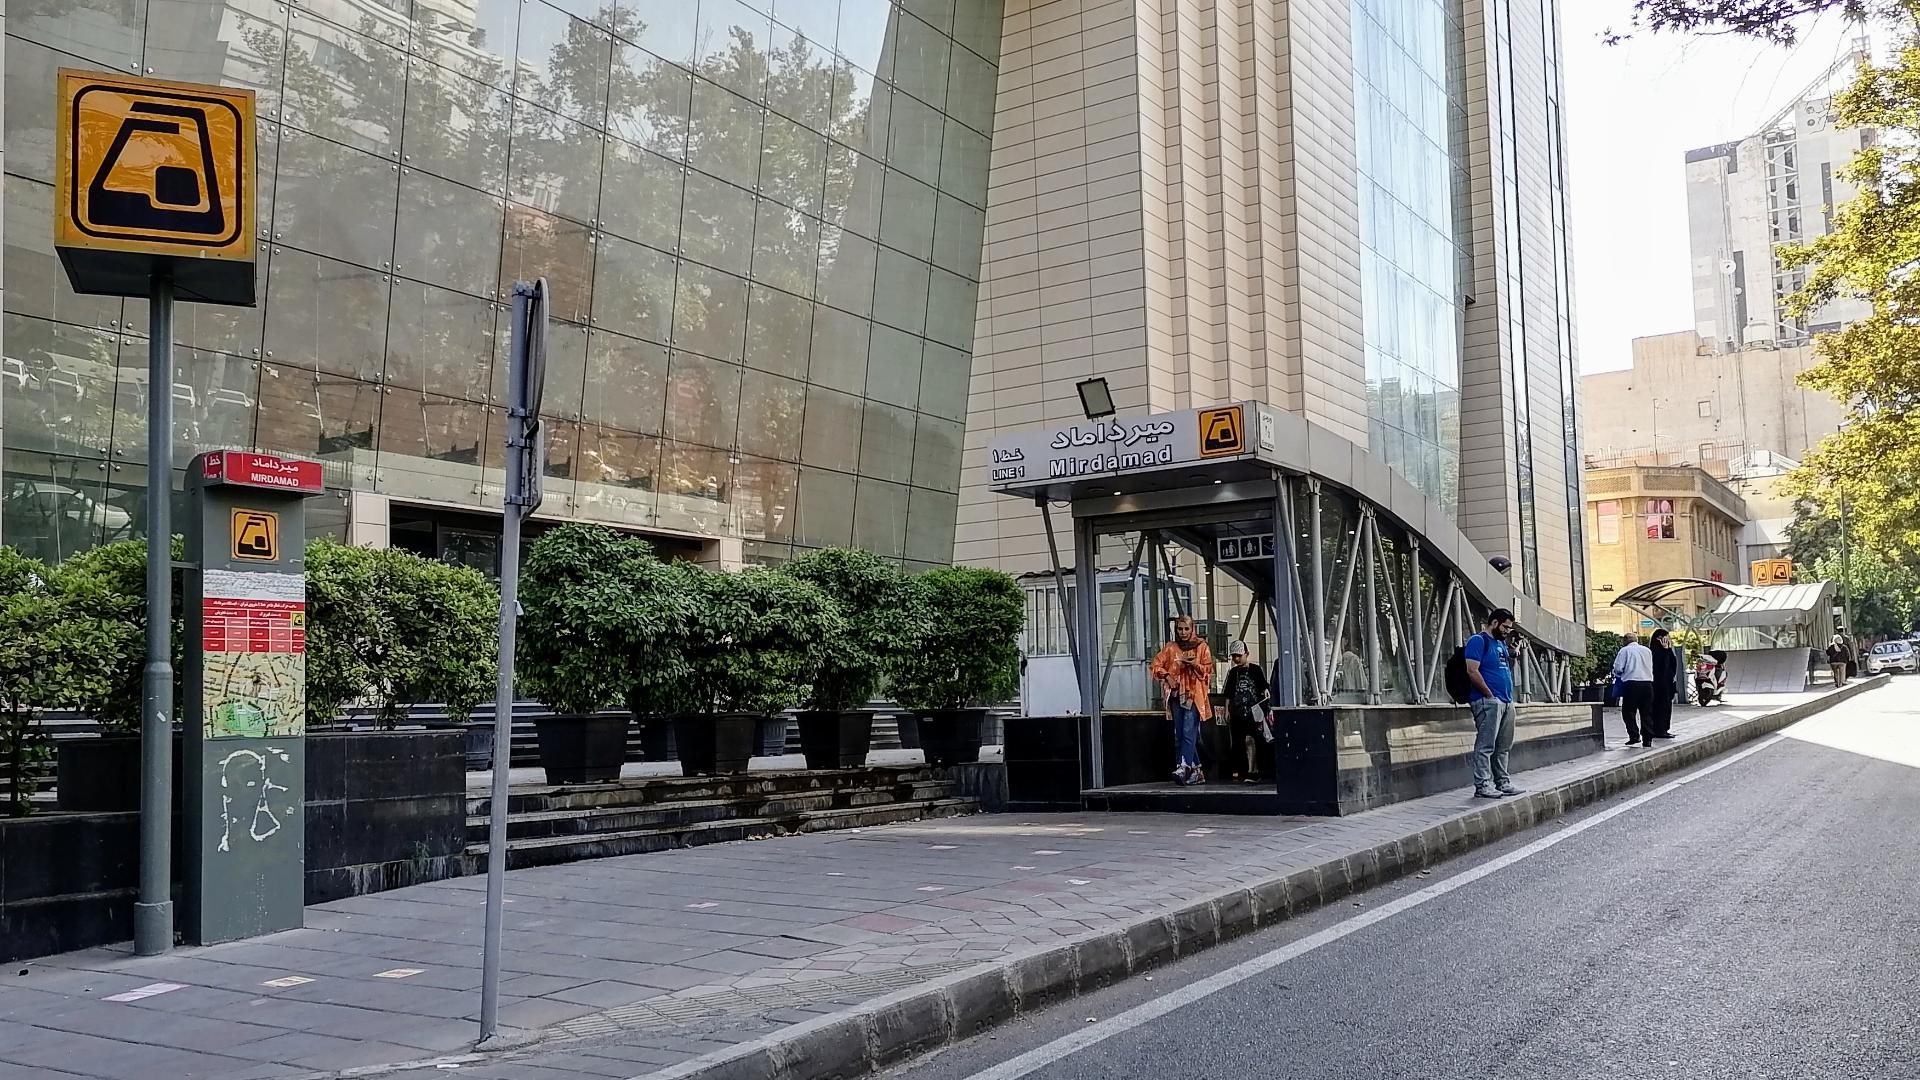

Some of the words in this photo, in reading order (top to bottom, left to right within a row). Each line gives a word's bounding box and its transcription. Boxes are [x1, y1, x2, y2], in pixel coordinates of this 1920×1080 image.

[1051, 421, 1174, 449] میرداماد
[209, 455, 221, 466] خط
[1000, 448, 1024, 462] خط
[1050, 444, 1172, 476] Mirdamad
[252, 457, 299, 473] میرداماد
[251, 472, 299, 487] MIRDAMAD
[993, 467, 1016, 480] LINE
[1018, 466, 1025, 477] 1
